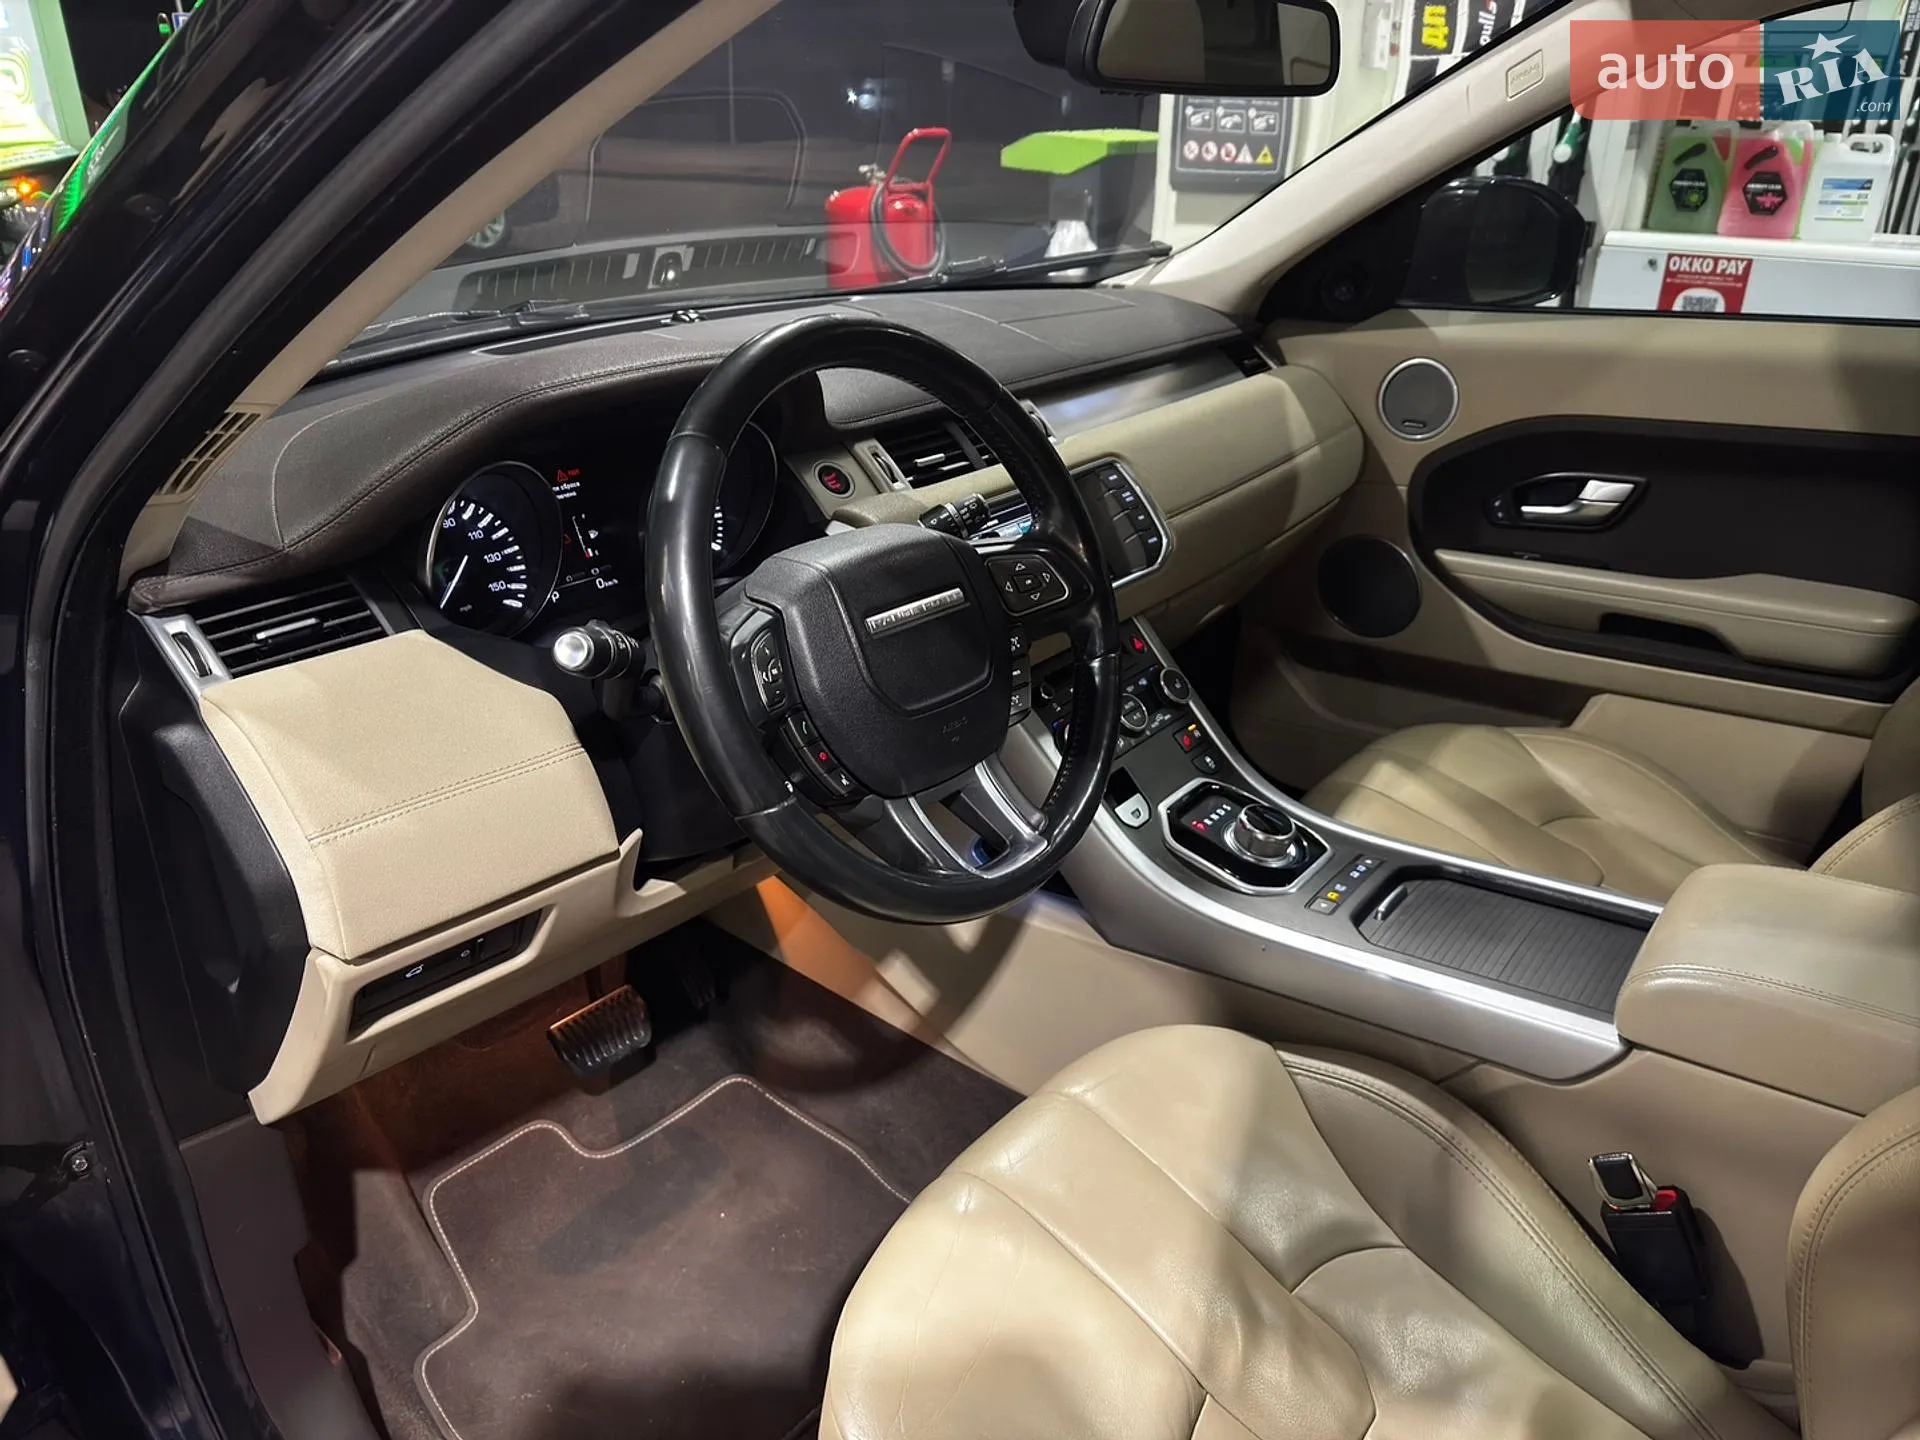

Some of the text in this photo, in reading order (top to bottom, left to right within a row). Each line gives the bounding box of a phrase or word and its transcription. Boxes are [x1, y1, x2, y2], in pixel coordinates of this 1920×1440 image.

[1422, 5, 1449, 49] ДП
[1669, 256, 1748, 276] OKKO PAY
[468, 530, 484, 540] 110
[484, 552, 502, 563] 130
[488, 580, 506, 592] 150
[551, 591, 560, 603] P
